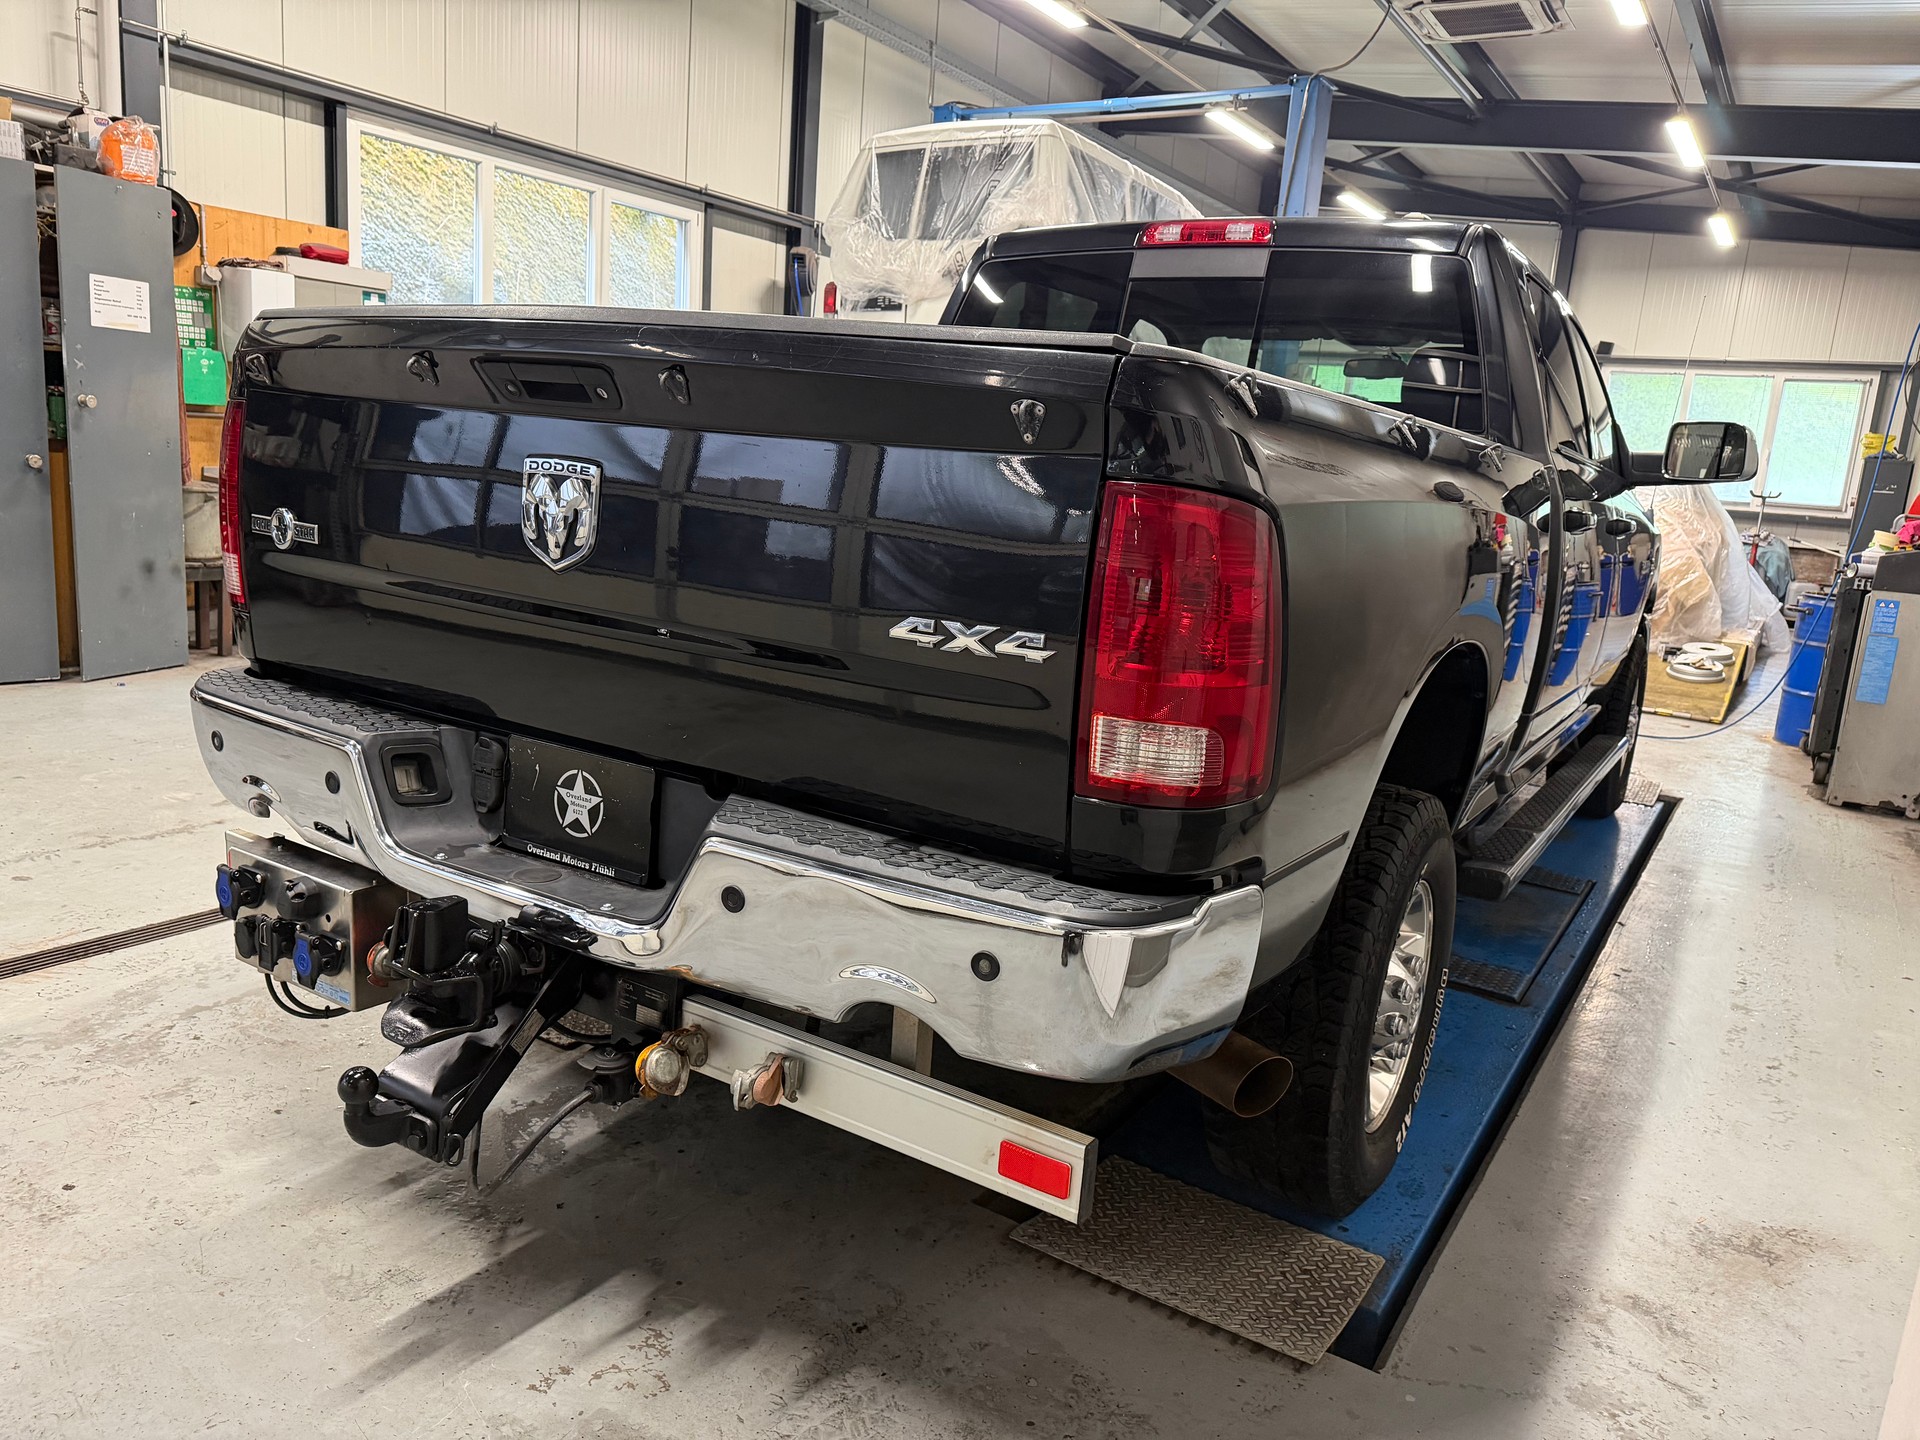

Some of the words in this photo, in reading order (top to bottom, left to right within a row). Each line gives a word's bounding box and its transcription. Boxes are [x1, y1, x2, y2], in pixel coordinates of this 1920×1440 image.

[529, 460, 591, 476] DODGE
[294, 526, 315, 540] STAR
[888, 616, 1058, 664] 4X4
[565, 791, 592, 804] Overland
[570, 800, 587, 810] Motors
[527, 844, 561, 861] Overland
[562, 854, 590, 871] Motors
[591, 862, 615, 877] Flühli
